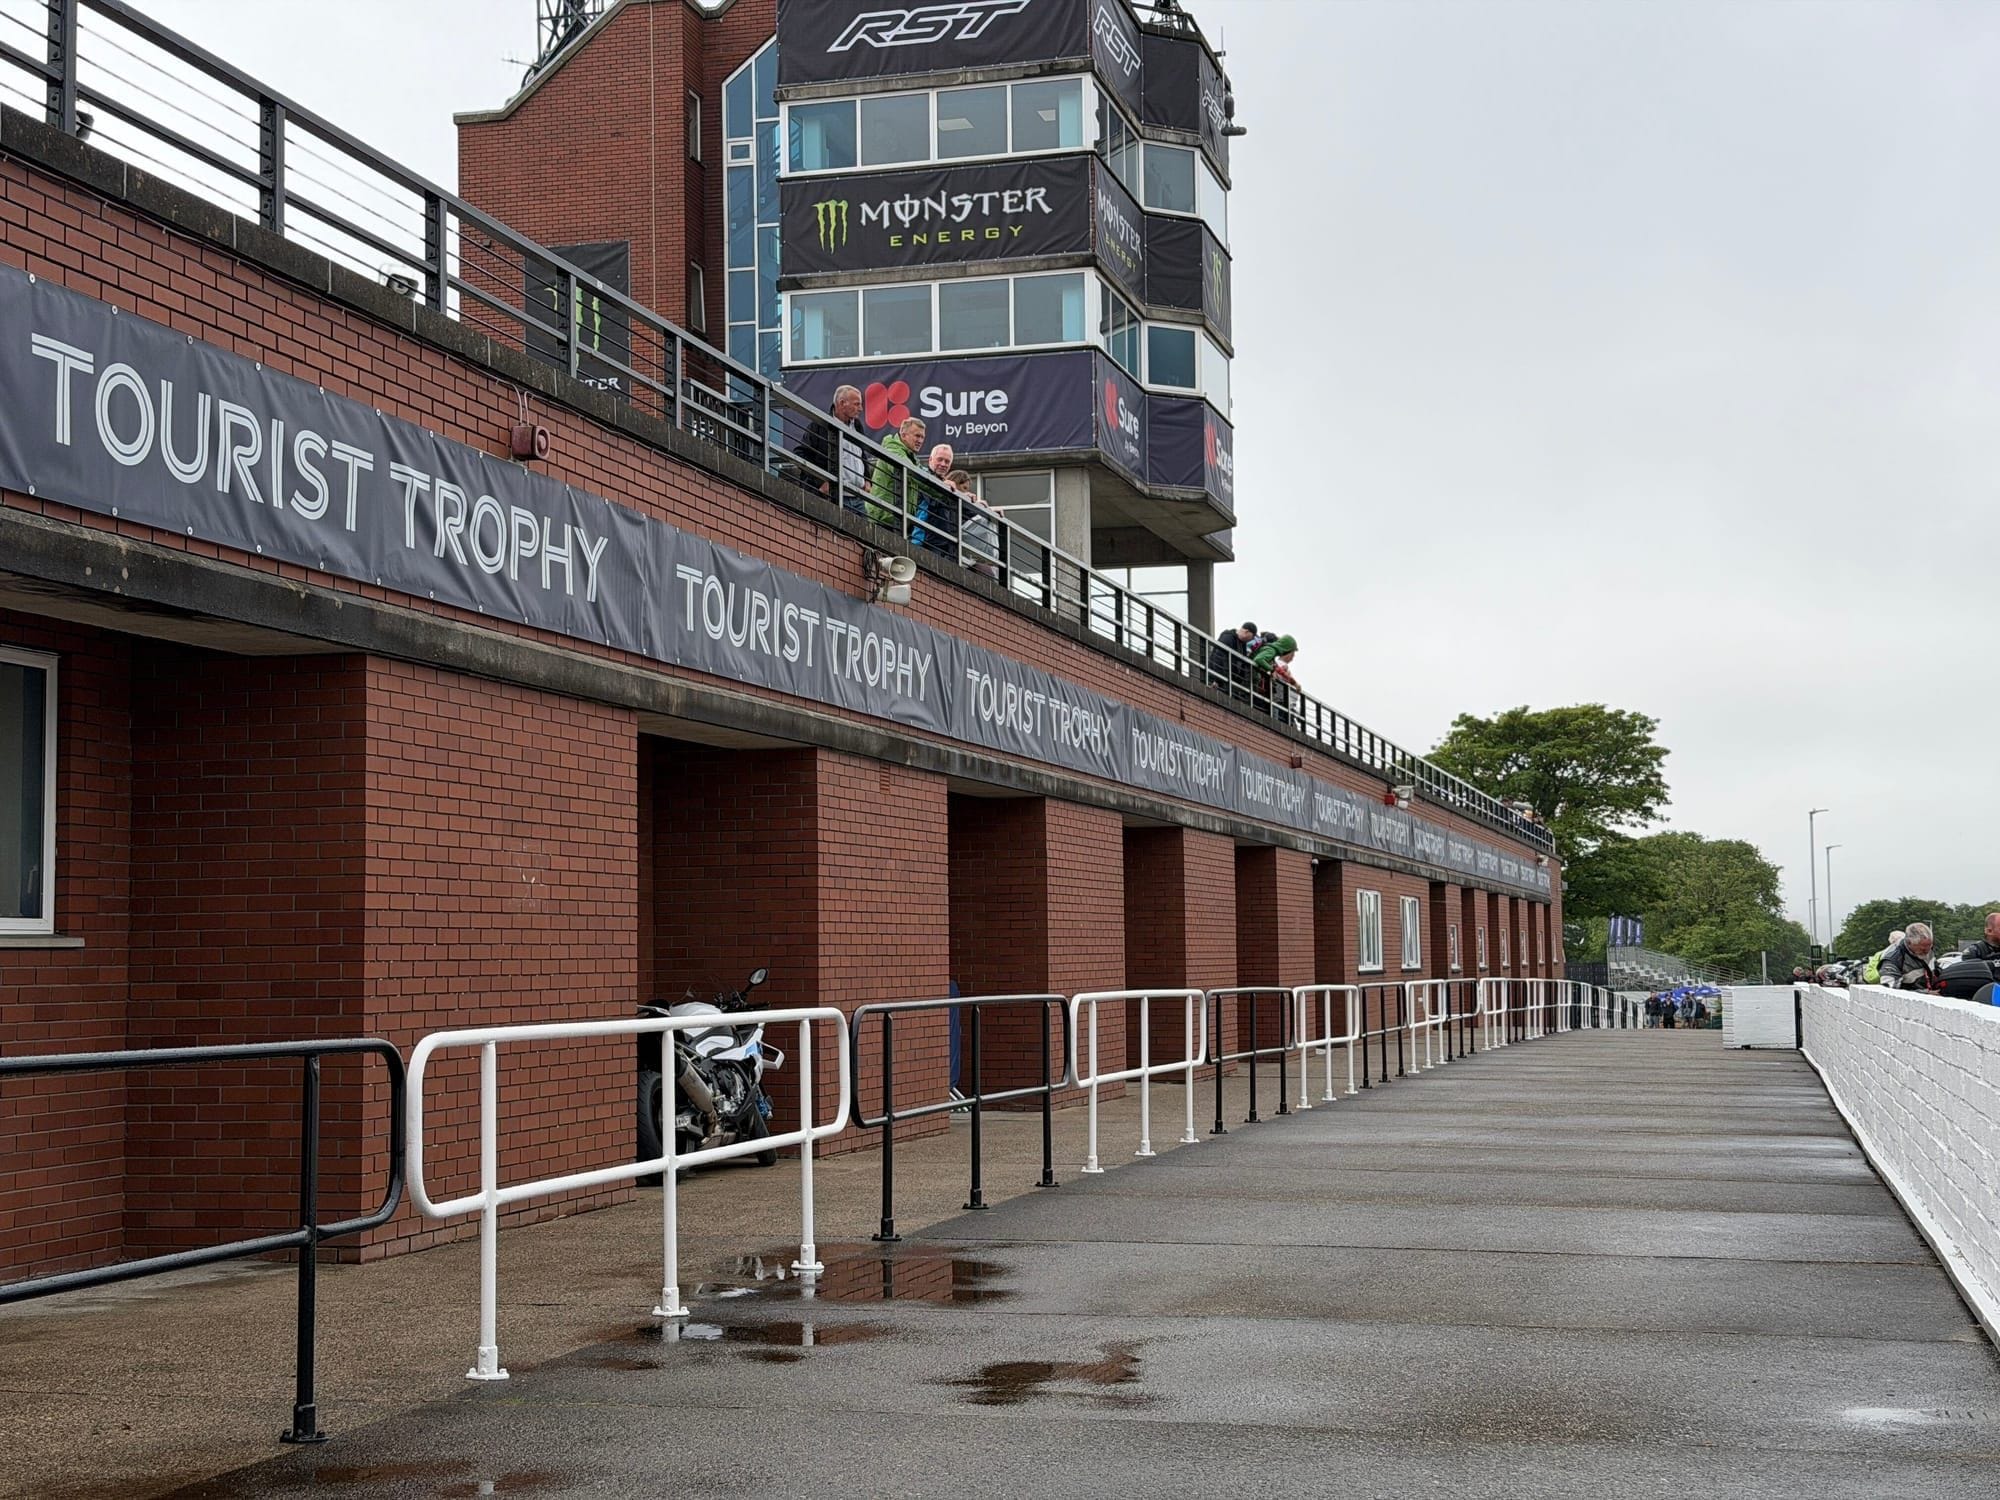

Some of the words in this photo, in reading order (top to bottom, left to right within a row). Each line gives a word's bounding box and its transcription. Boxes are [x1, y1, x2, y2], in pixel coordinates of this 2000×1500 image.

[826, 0, 1031, 53] RST
[1093, 6, 1141, 77] RST
[859, 187, 1053, 230] MONSTER
[1098, 188, 1143, 262] MONSTER
[889, 224, 1024, 248] ENERGY
[1105, 232, 1137, 273] ENERGY
[919, 386, 1009, 418] Sure
[1118, 397, 1140, 440] Sure
[945, 424, 963, 438] by
[965, 421, 1008, 435] Beyon
[31, 332, 374, 532] TOURIST
[390, 461, 608, 602] TROPHY
[676, 563, 820, 668] TOURIST
[826, 617, 932, 702] TROPHY
[966, 667, 1046, 736] TOURIST
[1049, 698, 1112, 757] TROPHY
[1132, 727, 1183, 778] TOURIST
[1184, 746, 1227, 792] TROPHY
[1240, 765, 1275, 806] TOURIST
